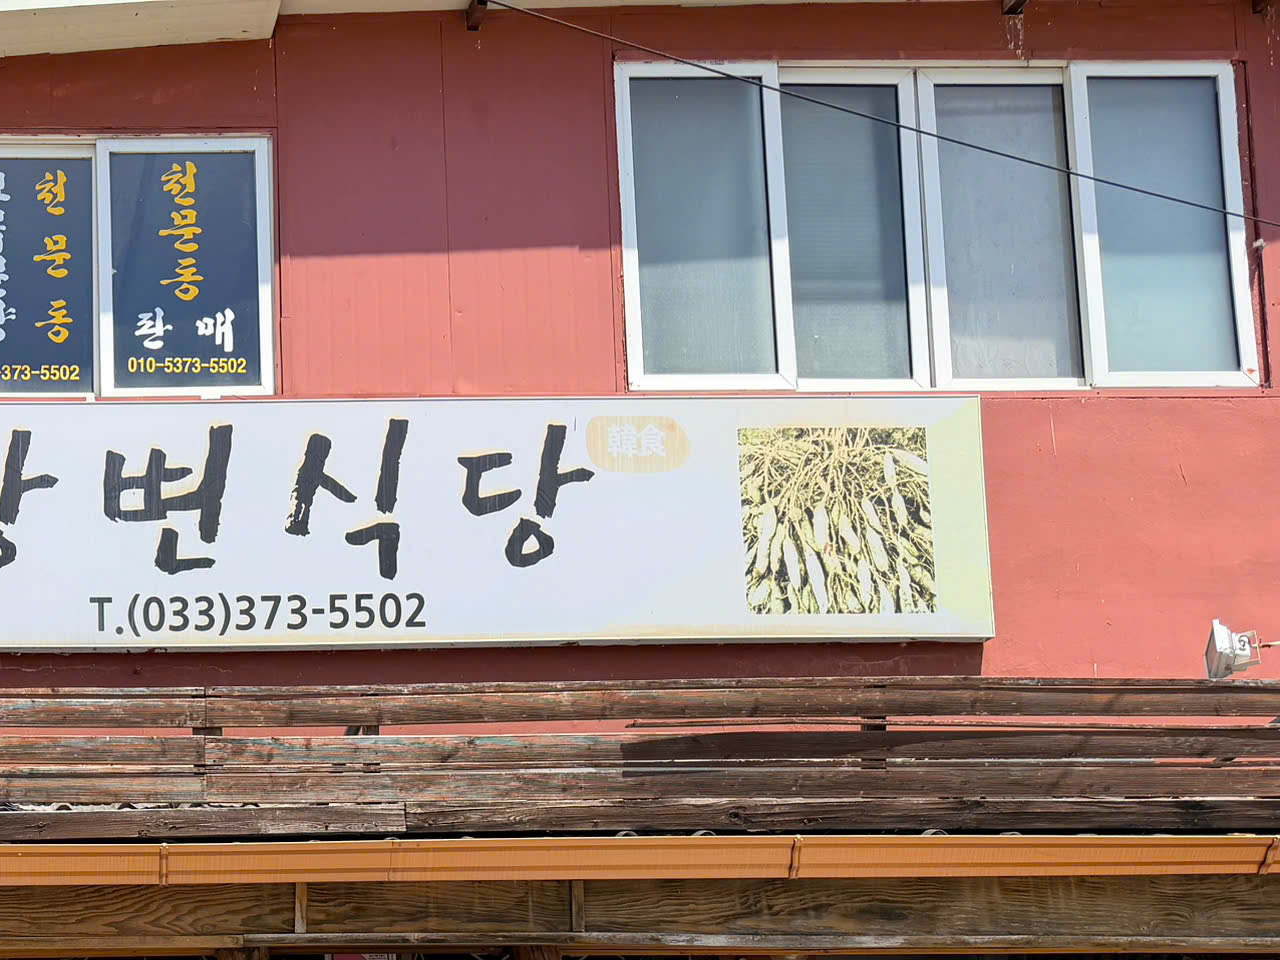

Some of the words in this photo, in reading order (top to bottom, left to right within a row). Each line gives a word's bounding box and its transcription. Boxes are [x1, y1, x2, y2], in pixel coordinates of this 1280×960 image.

[158, 161, 204, 301] 천문동
[33, 169, 73, 343] 천문동
[134, 307, 236, 352] 판매
[127, 357, 247, 374] 010-5373-5502
[89, 592, 426, 637] T.(033)373-5502
